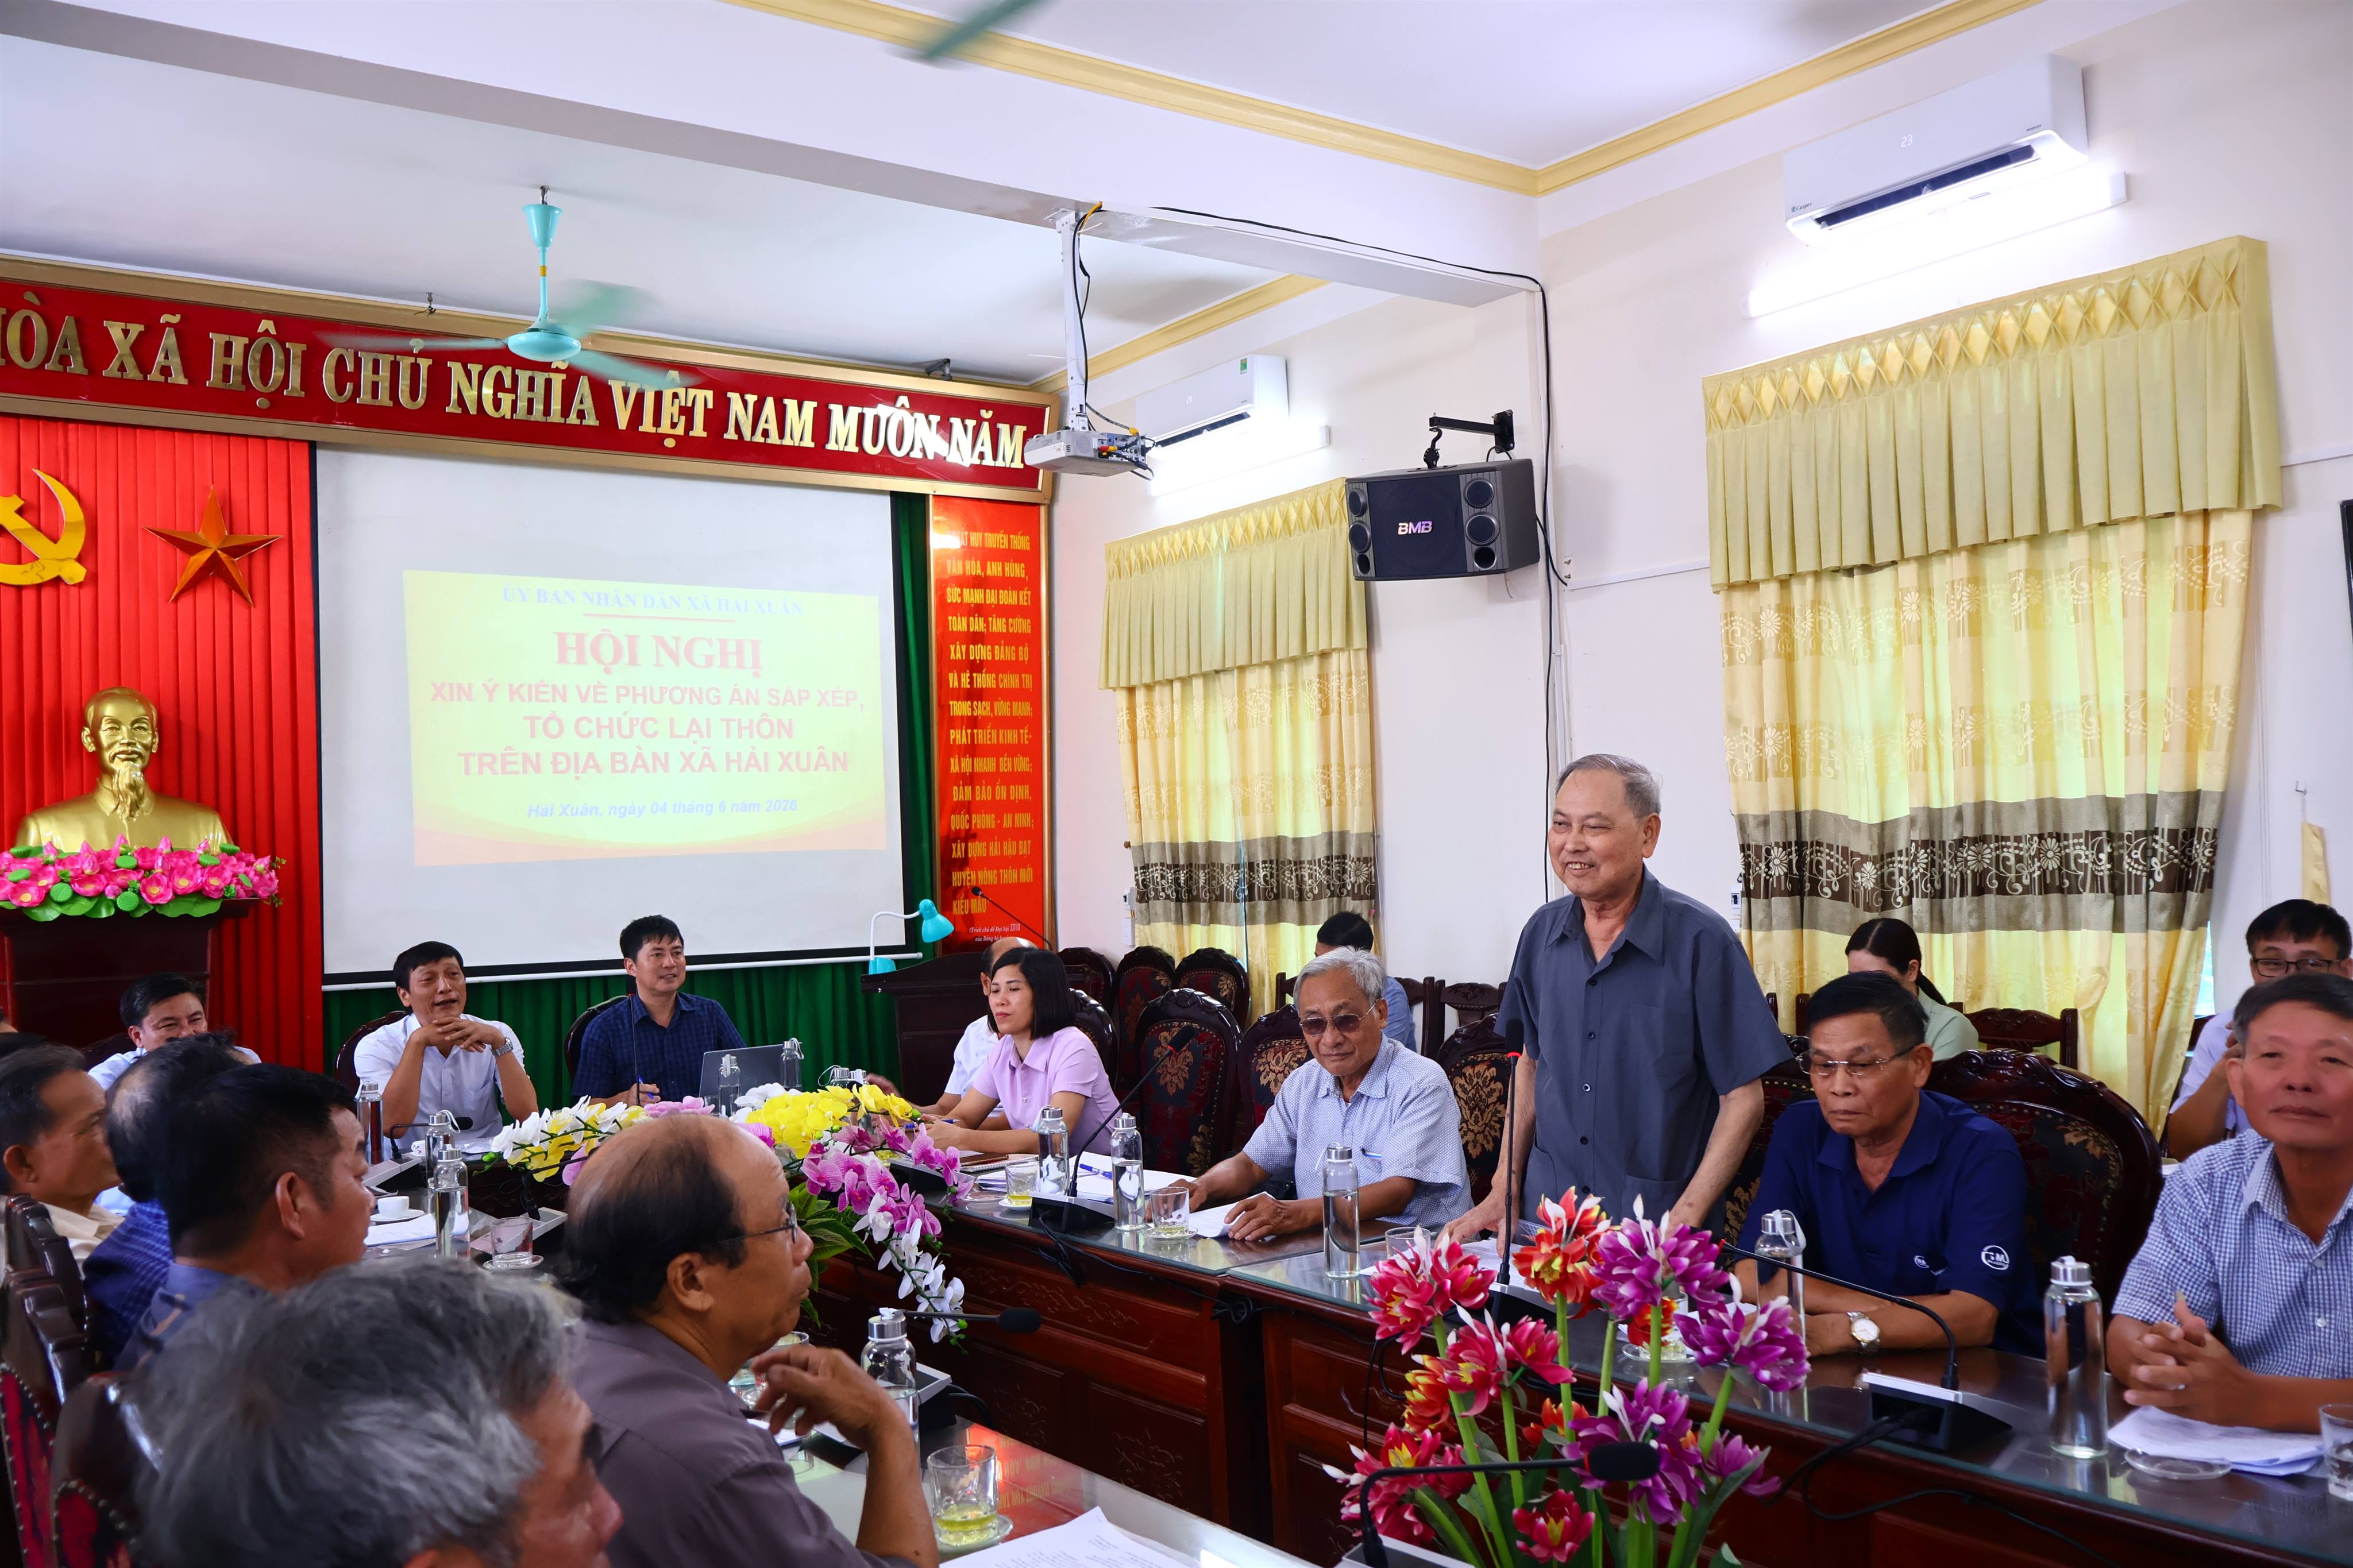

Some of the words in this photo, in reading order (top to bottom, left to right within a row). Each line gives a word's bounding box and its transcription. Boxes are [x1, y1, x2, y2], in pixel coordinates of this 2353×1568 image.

[1796, 202, 1812, 211] Casper
[0, 291, 88, 375] ÒA
[103, 314, 188, 385] XÃ
[206, 319, 307, 408] HỘI
[322, 338, 433, 410] CHỦ
[446, 360, 599, 426] NGHĨA
[608, 370, 713, 448] VIỆT
[723, 391, 817, 448] NAM
[826, 395, 943, 460] MUÔN
[946, 409, 1027, 469] NĂM
[1397, 520, 1433, 535] BMB
[970, 531, 983, 547] HUY
[1010, 531, 1030, 551] THỐNG
[986, 561, 1002, 576] ANH
[535, 588, 576, 604] BAN
[581, 589, 638, 608] NHÂN
[642, 591, 682, 610] DÂN
[686, 593, 712, 611] XÃ
[717, 595, 750, 613] HẢI
[753, 598, 804, 616] XUÂN
[947, 584, 961, 603] SỨC
[963, 588, 984, 607] MẠNH
[999, 586, 1017, 605] ĐOÀN
[1019, 586, 1031, 605] KẾT
[948, 613, 967, 632] TOÀN
[988, 614, 1006, 633] TĂNG
[1009, 615, 1031, 634] CƯỜNG
[553, 628, 641, 675] HỘI
[651, 635, 763, 678] NGHỊ
[950, 641, 966, 660] XÂY
[969, 643, 992, 663] DỰNG
[994, 640, 1016, 661] ĐẢNG
[1019, 643, 1029, 665] BỘ
[948, 670, 959, 688] VÀ
[973, 668, 996, 688] THỐNG
[998, 670, 1020, 689] CHÍNH
[1021, 674, 1033, 692] TRỊ
[430, 682, 474, 702] XIN
[481, 678, 499, 702] Ý
[508, 679, 568, 702] KIẾN
[575, 680, 608, 704] VỀ
[615, 685, 722, 705] PHƯƠNG
[728, 683, 761, 706] ÁN
[767, 685, 810, 706] SẮP
[949, 700, 971, 716] TRONG
[994, 697, 1011, 716] VỮNG
[522, 710, 565, 739] TỔ
[574, 710, 659, 739] CHỨC
[669, 717, 712, 745] LẠI
[720, 712, 794, 739] THÔN
[950, 725, 971, 745] PHÁT
[973, 723, 997, 745] TRIỂN
[999, 729, 1018, 744] KINH
[457, 746, 541, 775] TRÊN
[550, 751, 603, 781] ĐỊA
[610, 745, 670, 773] BÀN
[678, 746, 717, 773] XÃ
[725, 746, 769, 773] HẢI
[777, 745, 848, 772] XUÂN
[950, 755, 959, 773] XÃ
[961, 754, 972, 775] HỘI
[974, 757, 996, 773] NHANH
[952, 780, 972, 801] ĐẢM
[975, 780, 992, 801] BẢO
[527, 803, 554, 817] Hải
[608, 801, 646, 818] ngày
[650, 801, 668, 814] 04
[672, 800, 714, 816] tháng
[718, 800, 726, 812] 6
[730, 800, 761, 813] năm
[765, 799, 798, 812] 2026
[951, 809, 969, 832] QUỐC
[972, 810, 996, 829] PHÒNG
[1003, 813, 1012, 828] AN
[951, 839, 966, 858] XÂY
[968, 840, 987, 860] DỰNG
[989, 836, 1001, 856] HẢI
[1003, 837, 1016, 859] HẬU
[1019, 840, 1031, 858] ĐẠT
[952, 867, 976, 889] HUYỆN
[978, 867, 998, 885] NÔNG
[1000, 866, 1018, 884] THÔN
[1020, 864, 1033, 883] MỚI
[952, 893, 969, 914] KIỂU
